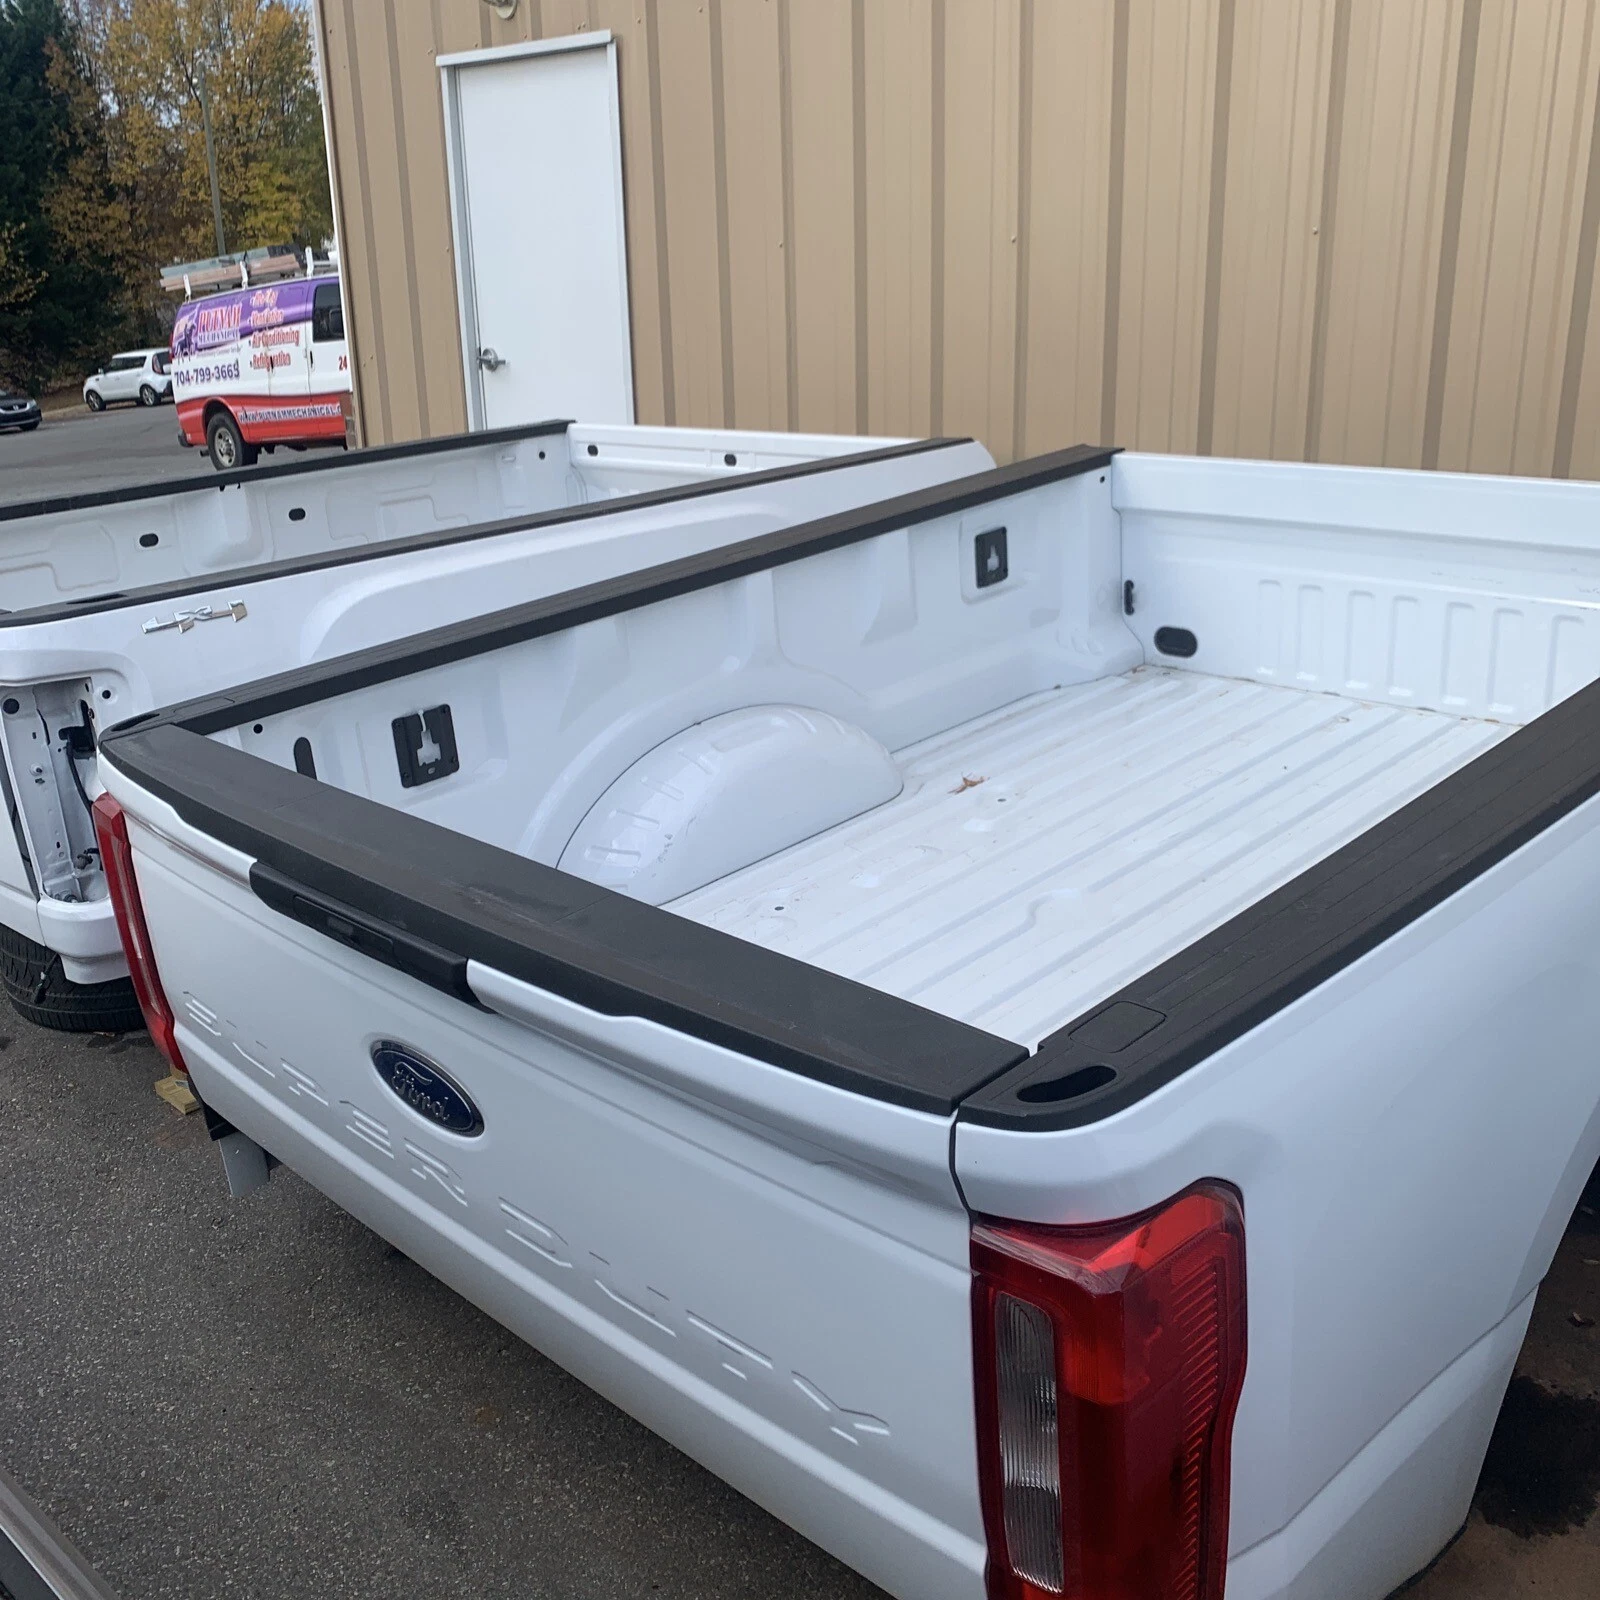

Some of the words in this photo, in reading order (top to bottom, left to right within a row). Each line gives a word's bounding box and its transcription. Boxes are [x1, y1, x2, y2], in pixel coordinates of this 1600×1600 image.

[253, 351, 291, 372] Refrigration
[338, 355, 348, 371] 24
[391, 1061, 451, 1121] Ford
